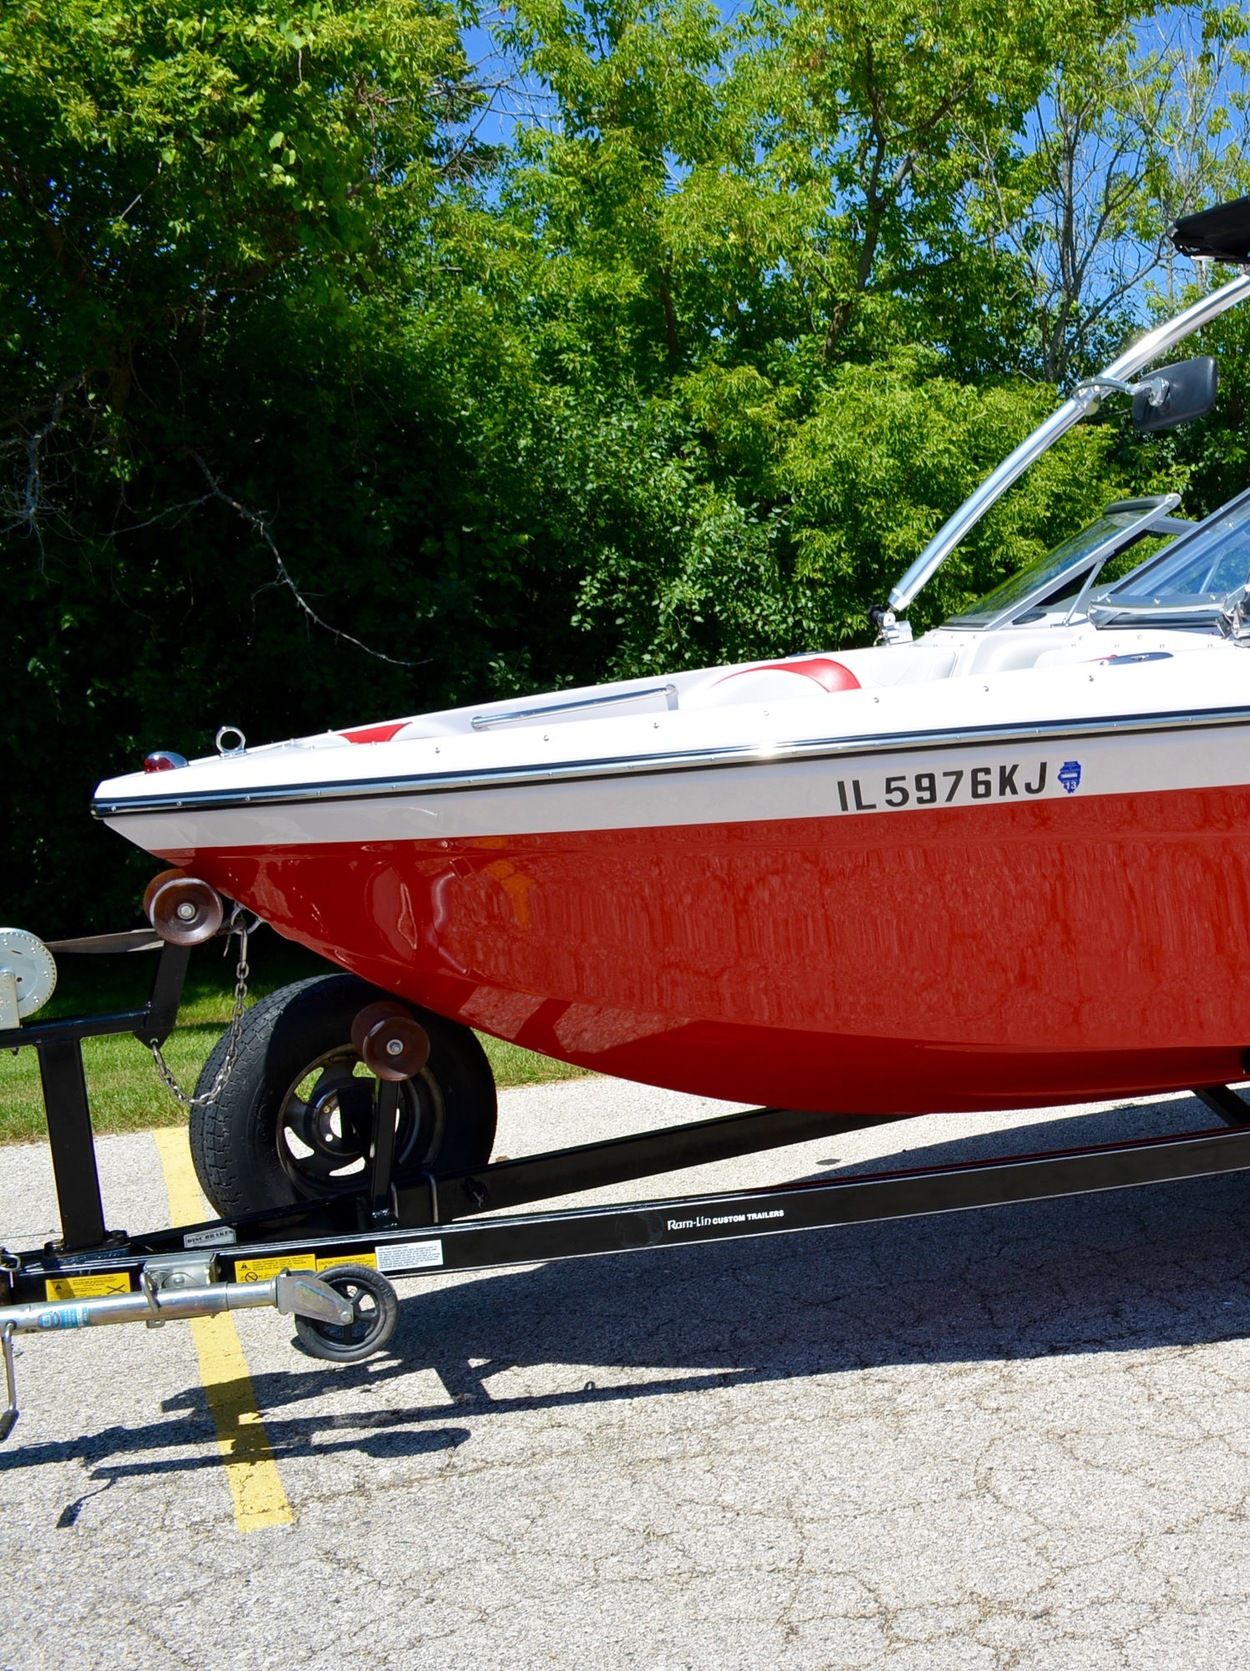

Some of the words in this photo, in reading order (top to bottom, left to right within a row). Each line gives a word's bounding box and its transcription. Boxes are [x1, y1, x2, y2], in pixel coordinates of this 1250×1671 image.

[667, 1216, 712, 1231] Ram-Lin
[712, 1214, 746, 1225] CUSTOM
[747, 1209, 785, 1221] TRAILERS
